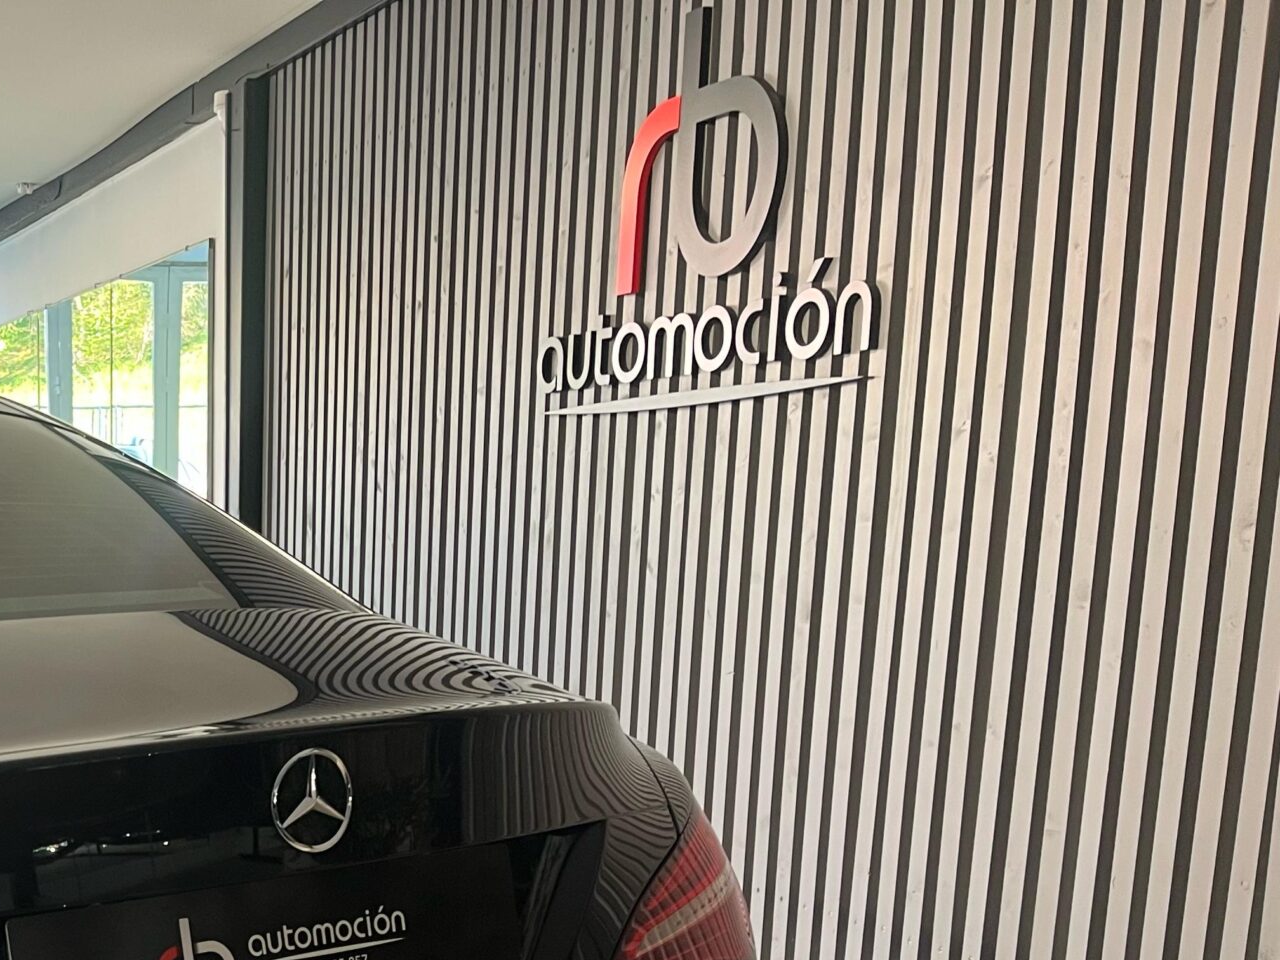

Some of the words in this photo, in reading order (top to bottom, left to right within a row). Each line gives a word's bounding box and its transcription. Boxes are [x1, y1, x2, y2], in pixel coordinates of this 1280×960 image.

[615, 6, 786, 297] rb
[535, 256, 878, 394] automoción
[248, 905, 406, 957] automoción
